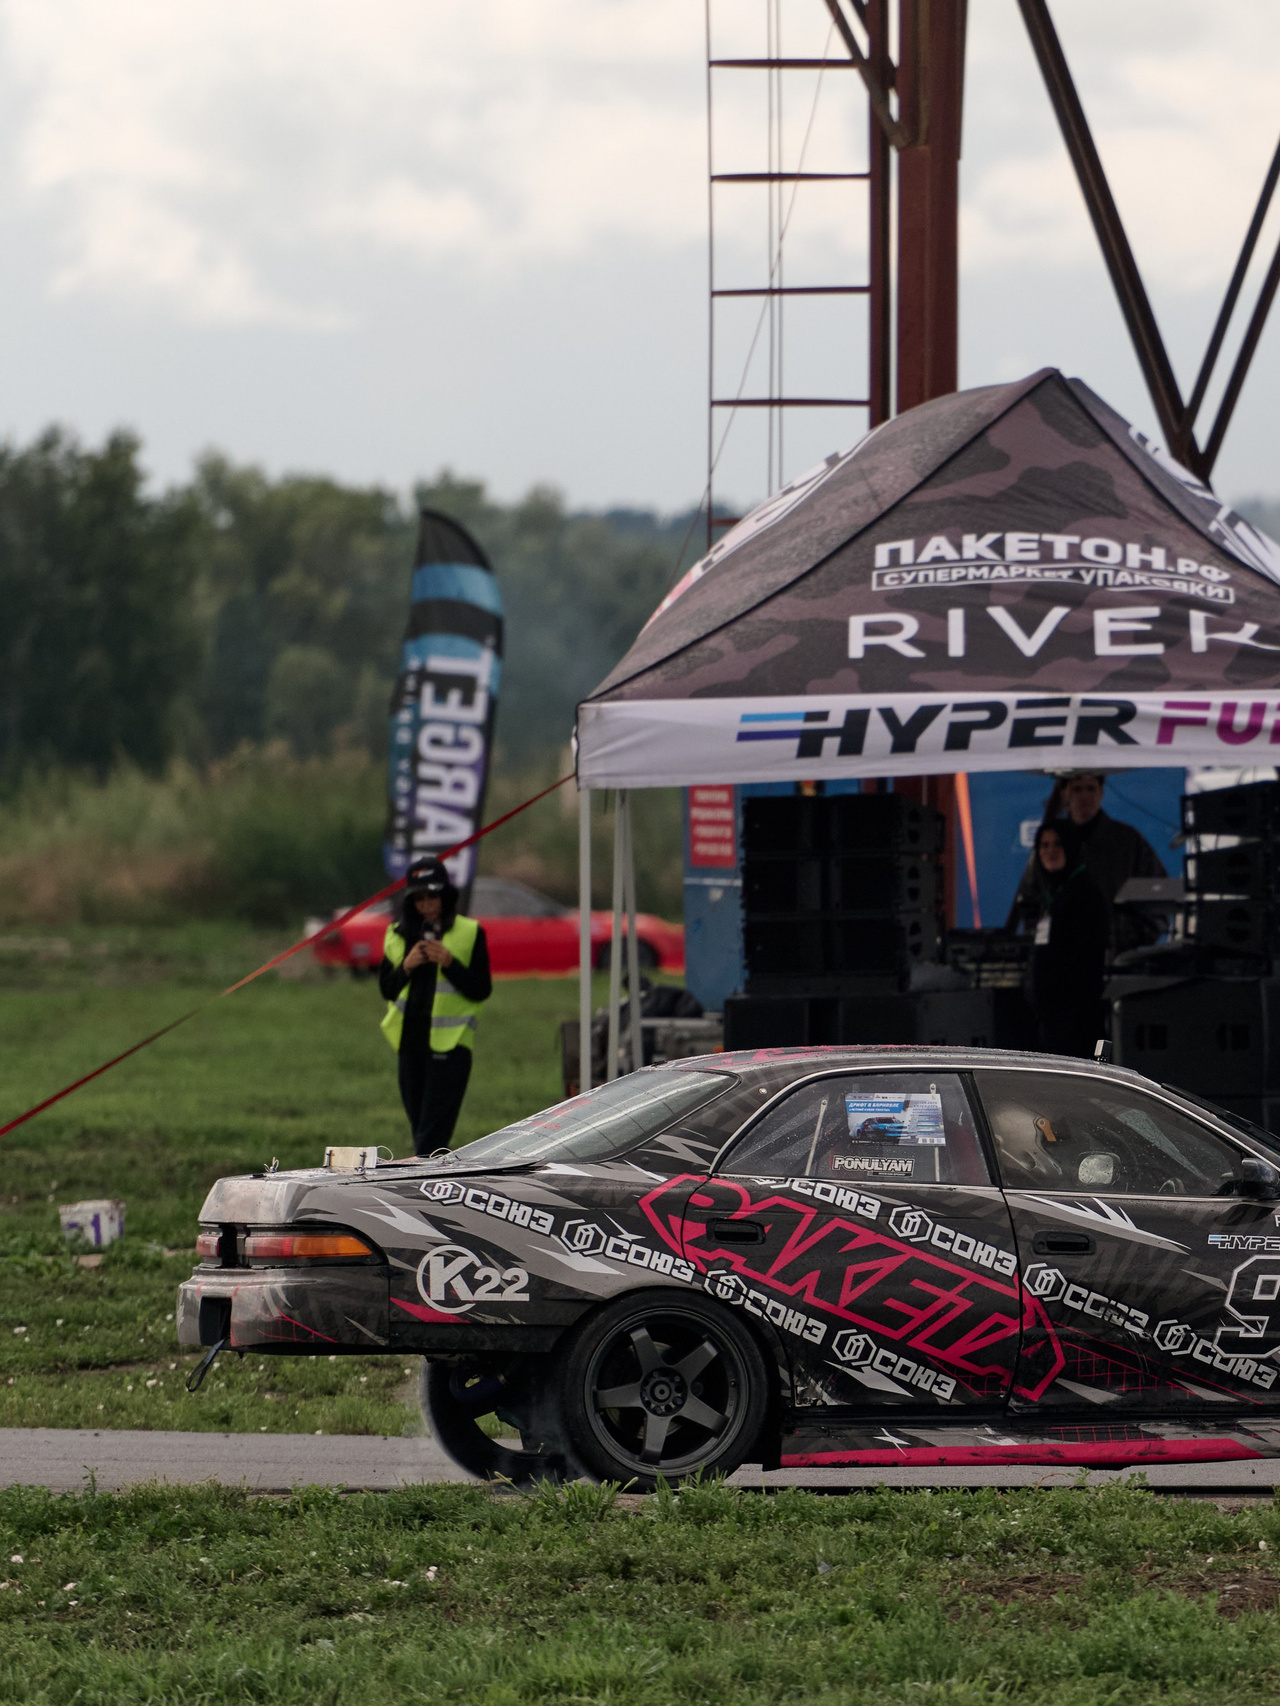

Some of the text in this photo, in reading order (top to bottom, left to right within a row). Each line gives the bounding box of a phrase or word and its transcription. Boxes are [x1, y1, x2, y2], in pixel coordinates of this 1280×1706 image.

[833, 1157, 913, 1172] PONULYAM
[464, 1189, 555, 1235] СОЮЗ
[791, 1178, 881, 1221] СОЮЗ
[605, 1237, 696, 1284] СОЮЗ
[931, 1227, 1018, 1277] СОЮЗ
[743, 1292, 827, 1344] СОЮЗ
[872, 1351, 957, 1400] СОЮЗ
[1192, 1338, 1279, 1390] СОЮЗ
